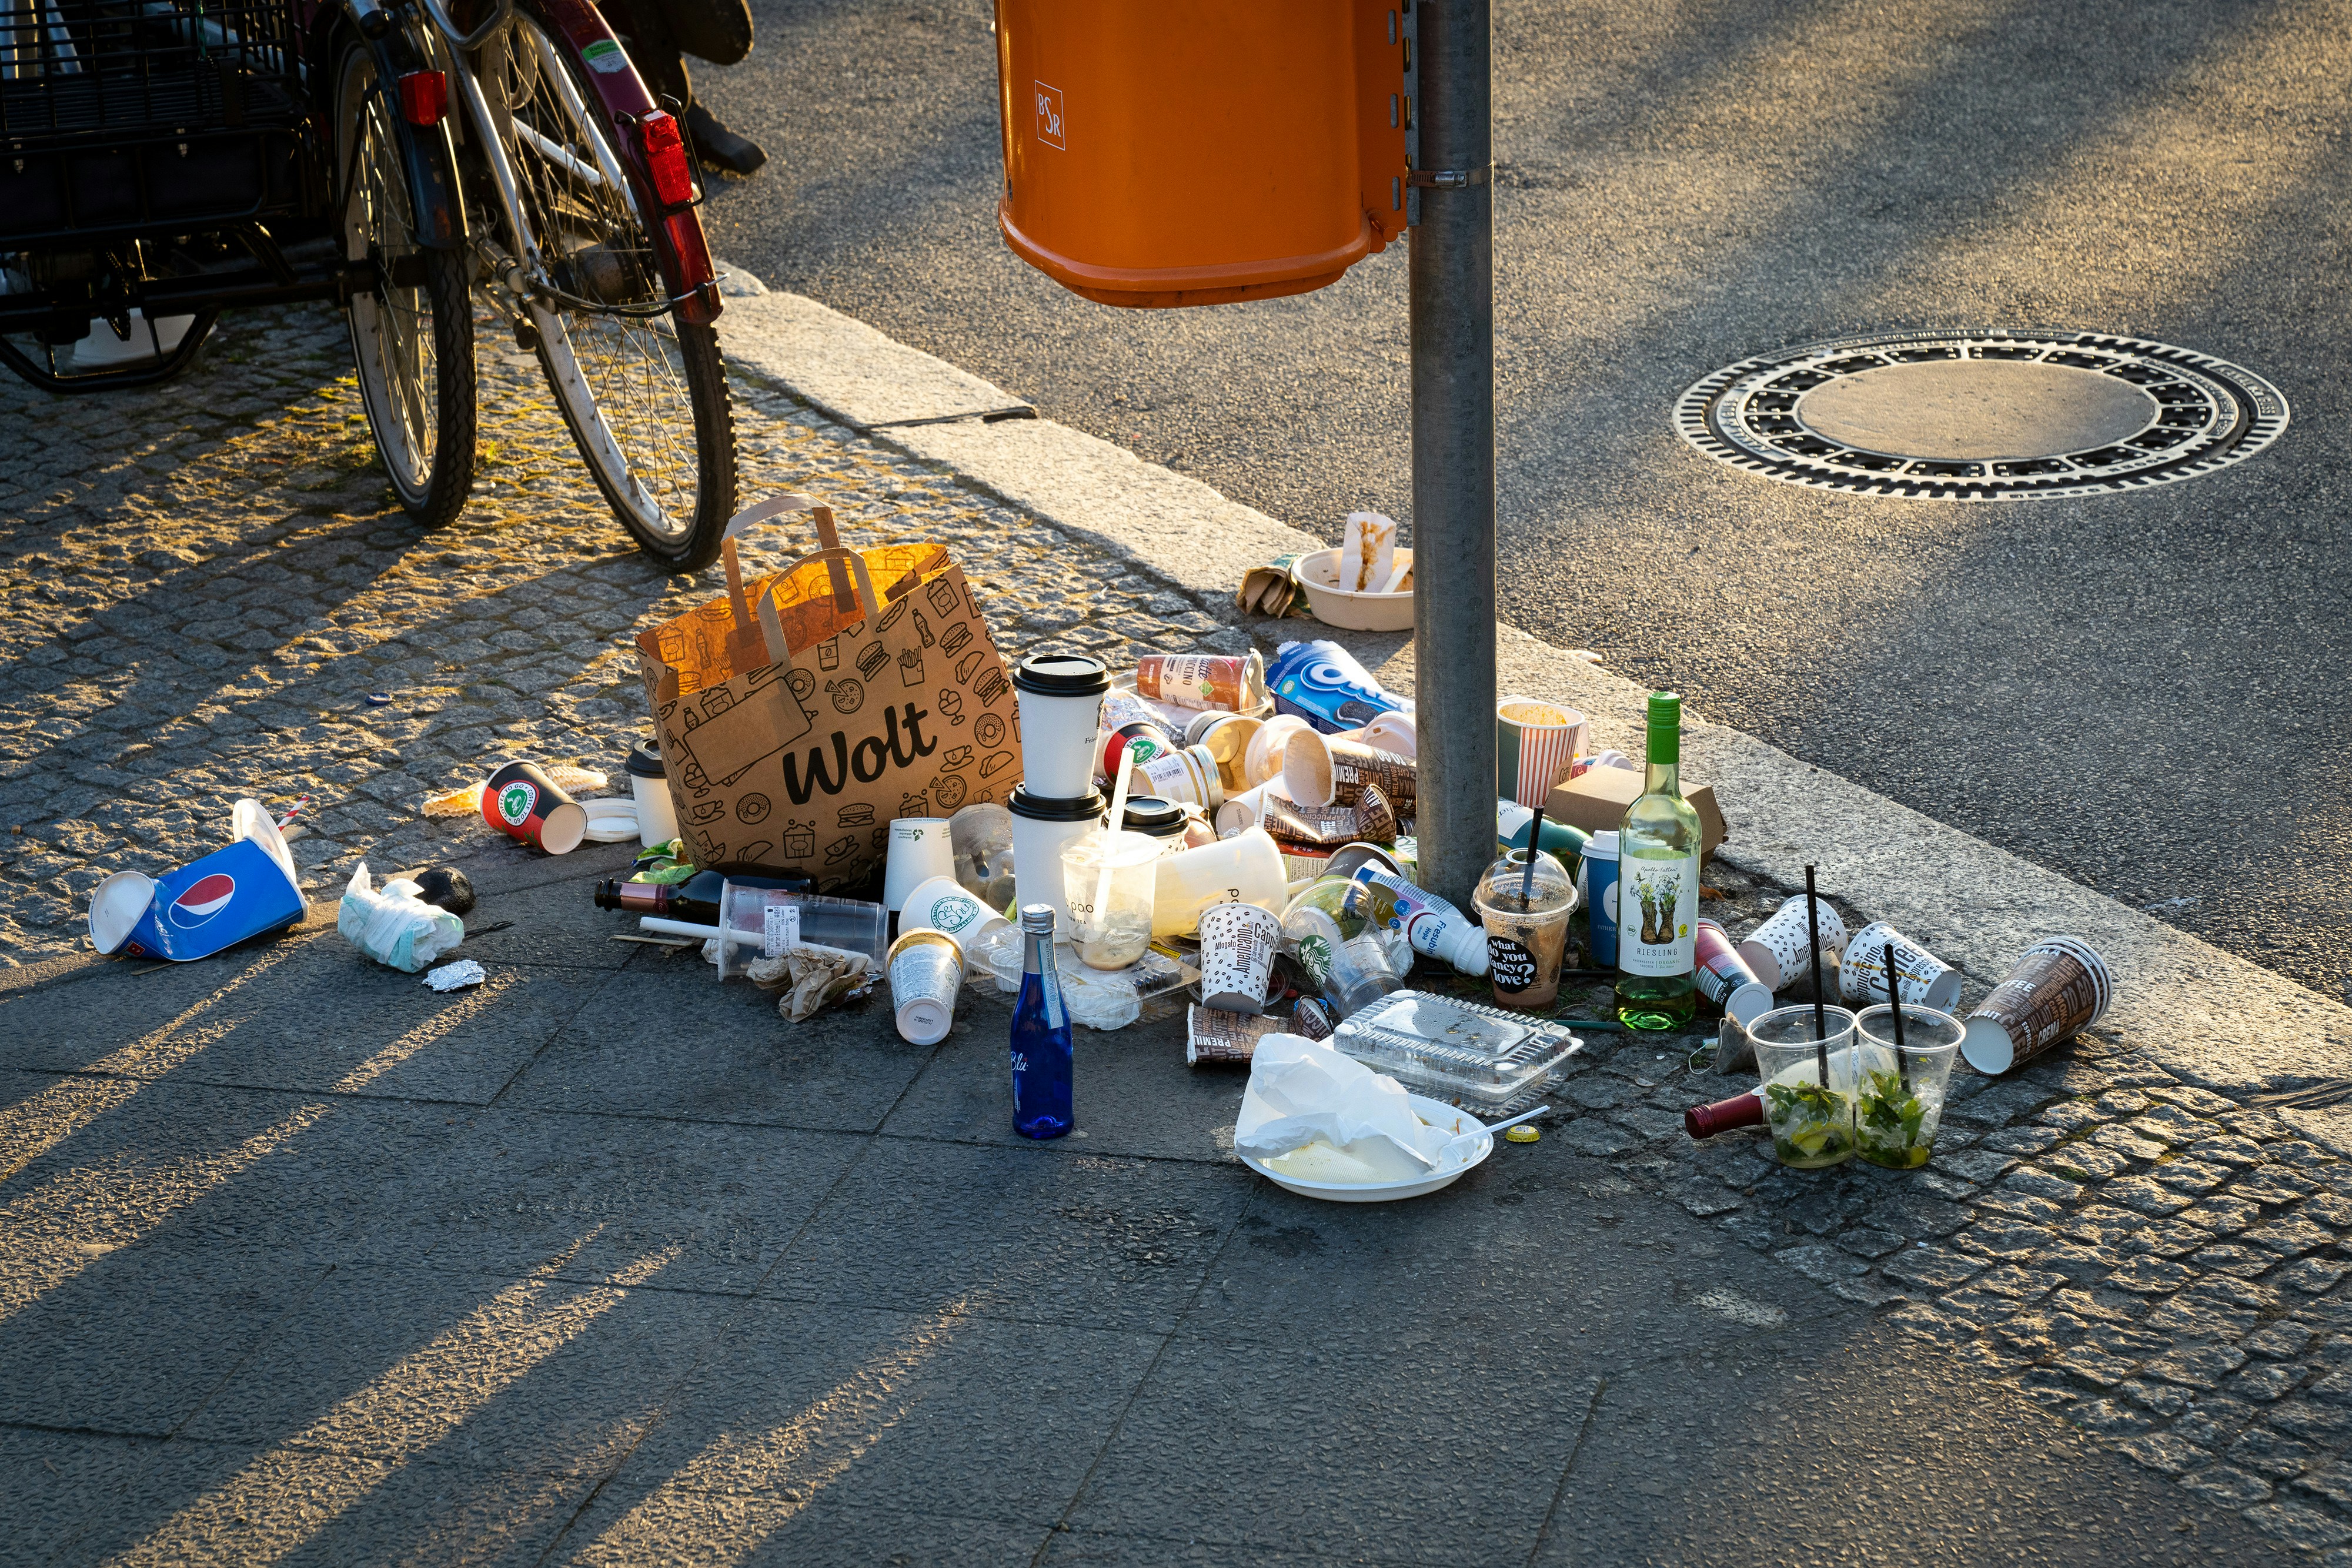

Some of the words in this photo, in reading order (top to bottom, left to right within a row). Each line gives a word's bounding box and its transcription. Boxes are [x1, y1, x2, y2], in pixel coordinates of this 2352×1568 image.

[1038, 93, 1061, 136] BSR
[783, 702, 937, 805] Wolt
[1375, 748, 1391, 763] GO
[1390, 752, 1406, 765] TO
[1390, 765, 1398, 795] MELANGE
[1071, 902, 1094, 913] pao
[1254, 922, 1276, 951] Capp
[1422, 927, 1432, 940] Hepa
[1426, 921, 1446, 955] Fresubin
[1215, 940, 1237, 951] Affogato
[1232, 928, 1253, 974] Americano
[1488, 944, 1499, 957] do
[1502, 953, 1528, 962] you
[1491, 940, 1516, 950] what
[1637, 948, 1678, 957] RIESLING
[1793, 934, 1828, 965] Amerno
[1489, 955, 1517, 974] fancy
[1909, 958, 1932, 981] Espresso
[1857, 946, 1881, 1003] Cappuccino
[2049, 971, 2066, 986] CAFE
[1903, 979, 1912, 991] milk
[2029, 981, 2062, 1009] CAPPUCCINO
[2062, 987, 2079, 1017] TO
[2076, 975, 2093, 1005] GO
[1251, 1016, 1277, 1027] PREMIUM
[1228, 1032, 1252, 1042] AFE
[1236, 1026, 1260, 1037] CREMA
[2037, 1019, 2060, 1047] CREMA
